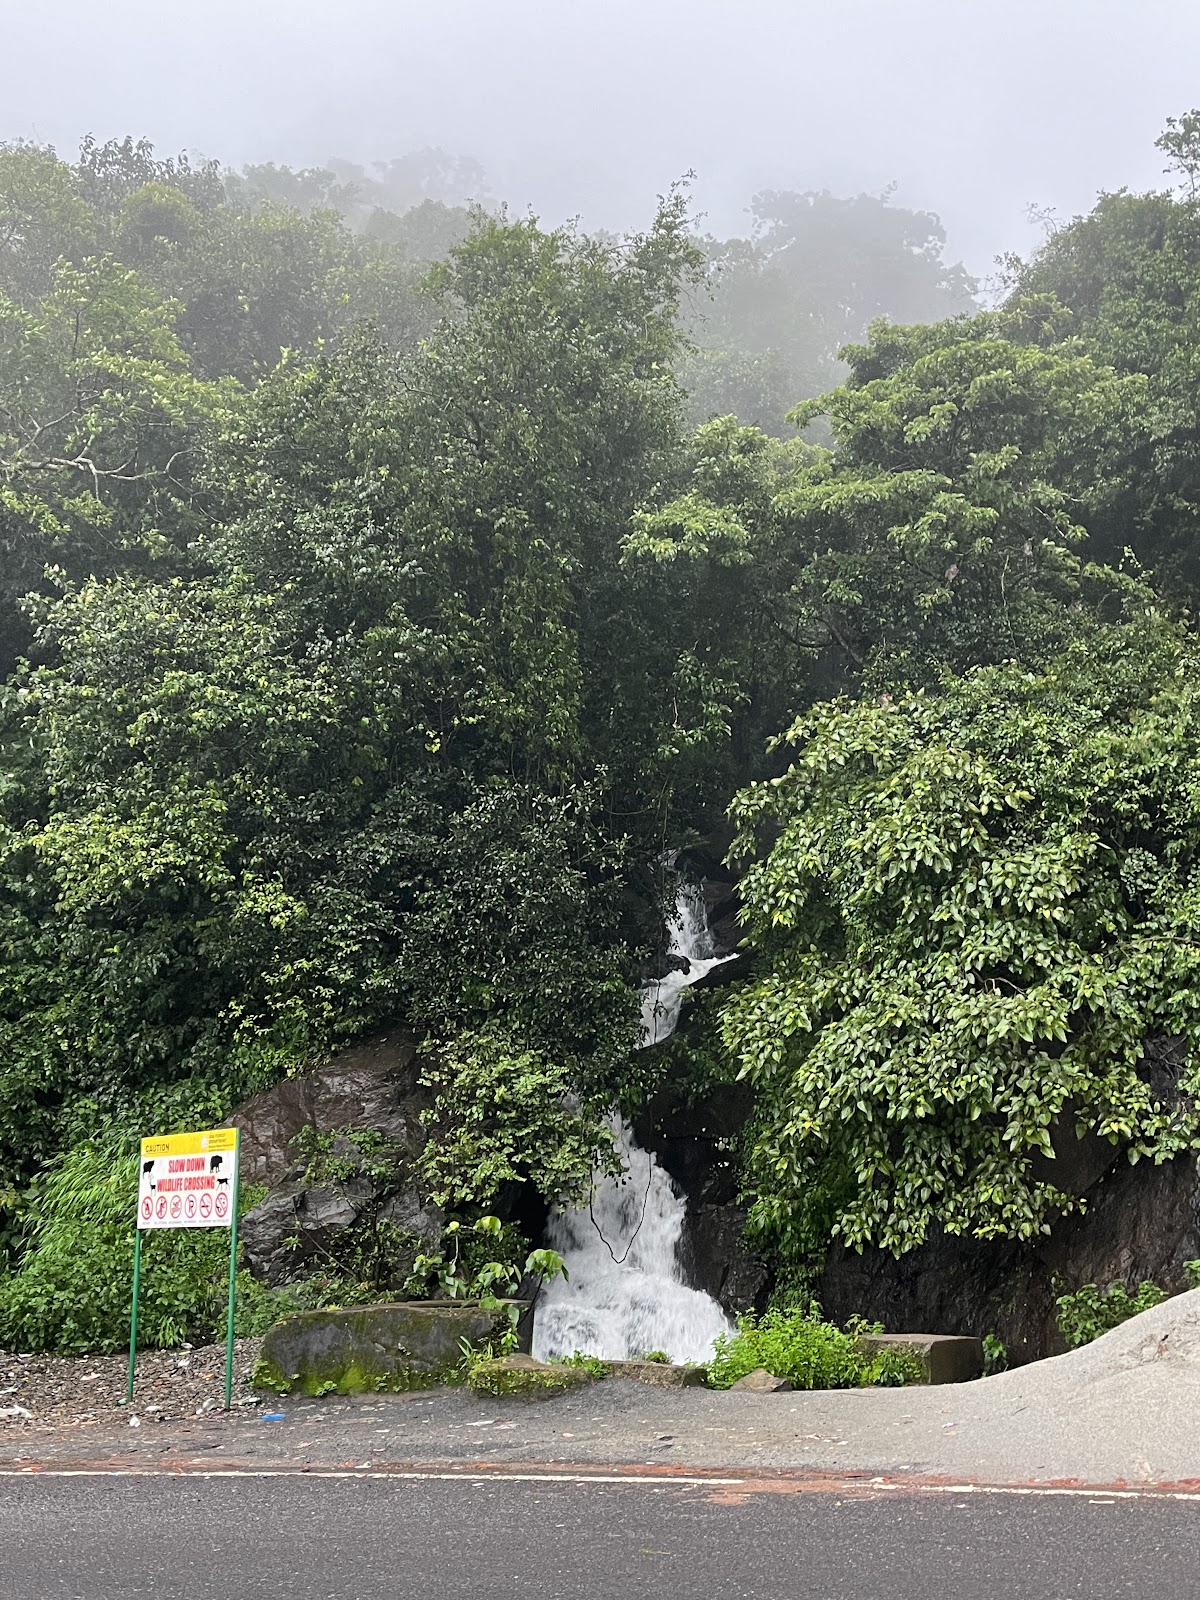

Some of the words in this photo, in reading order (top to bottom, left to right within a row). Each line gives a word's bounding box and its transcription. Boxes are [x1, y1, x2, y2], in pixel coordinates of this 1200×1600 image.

[145, 1143, 170, 1153] CAUTION
[168, 1159, 185, 1173] SLOW
[186, 1157, 205, 1172] DOWN
[157, 1177, 183, 1192] WILDLIFE
[184, 1175, 215, 1191] CROSSING
